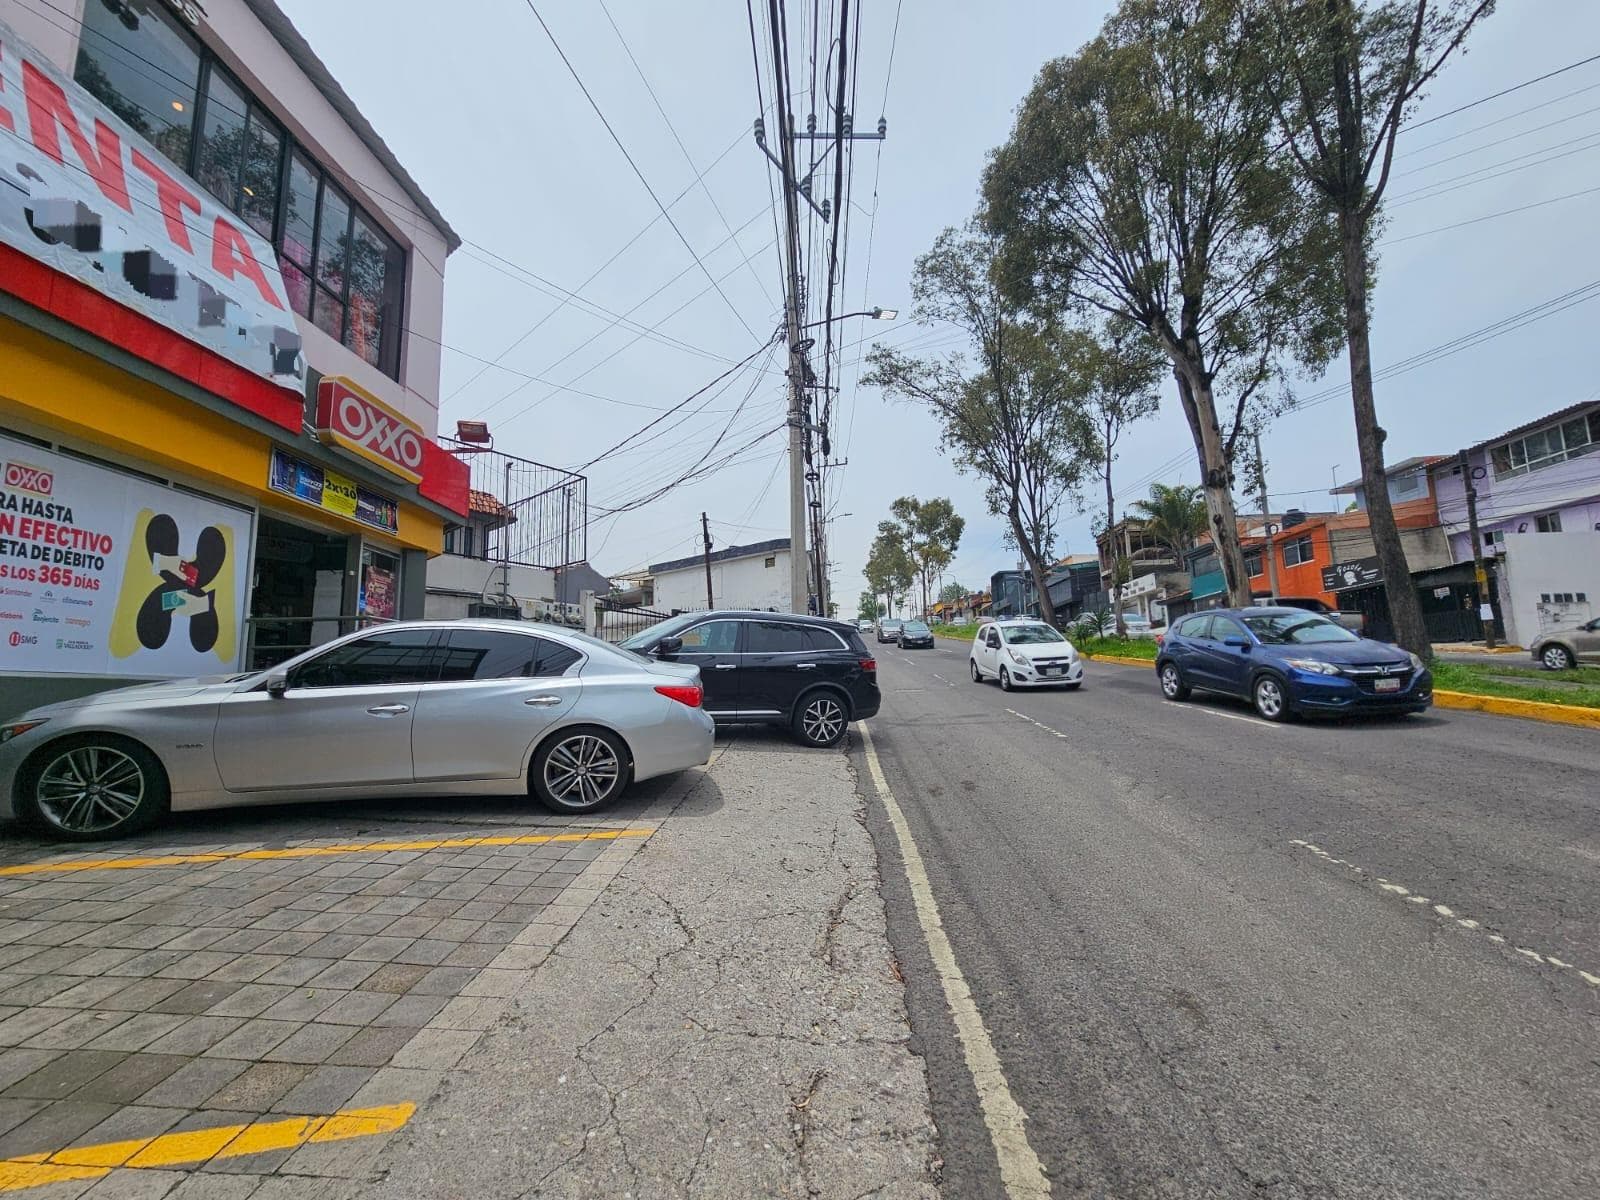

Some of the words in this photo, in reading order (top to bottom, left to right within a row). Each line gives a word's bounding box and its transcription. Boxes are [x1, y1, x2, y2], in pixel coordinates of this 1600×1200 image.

[0, 38, 286, 312] NTA
[340, 397, 422, 468] OXXO
[6, 465, 52, 493] OXXO
[21, 496, 74, 524] HASTA
[18, 516, 113, 555] EFECTIVO
[30, 543, 51, 562] DE
[53, 547, 105, 571] DÉBITO
[0, 564, 9, 578] S
[11, 565, 36, 582] LOS
[39, 564, 73, 587] 365
[74, 573, 101, 591] DÍAS
